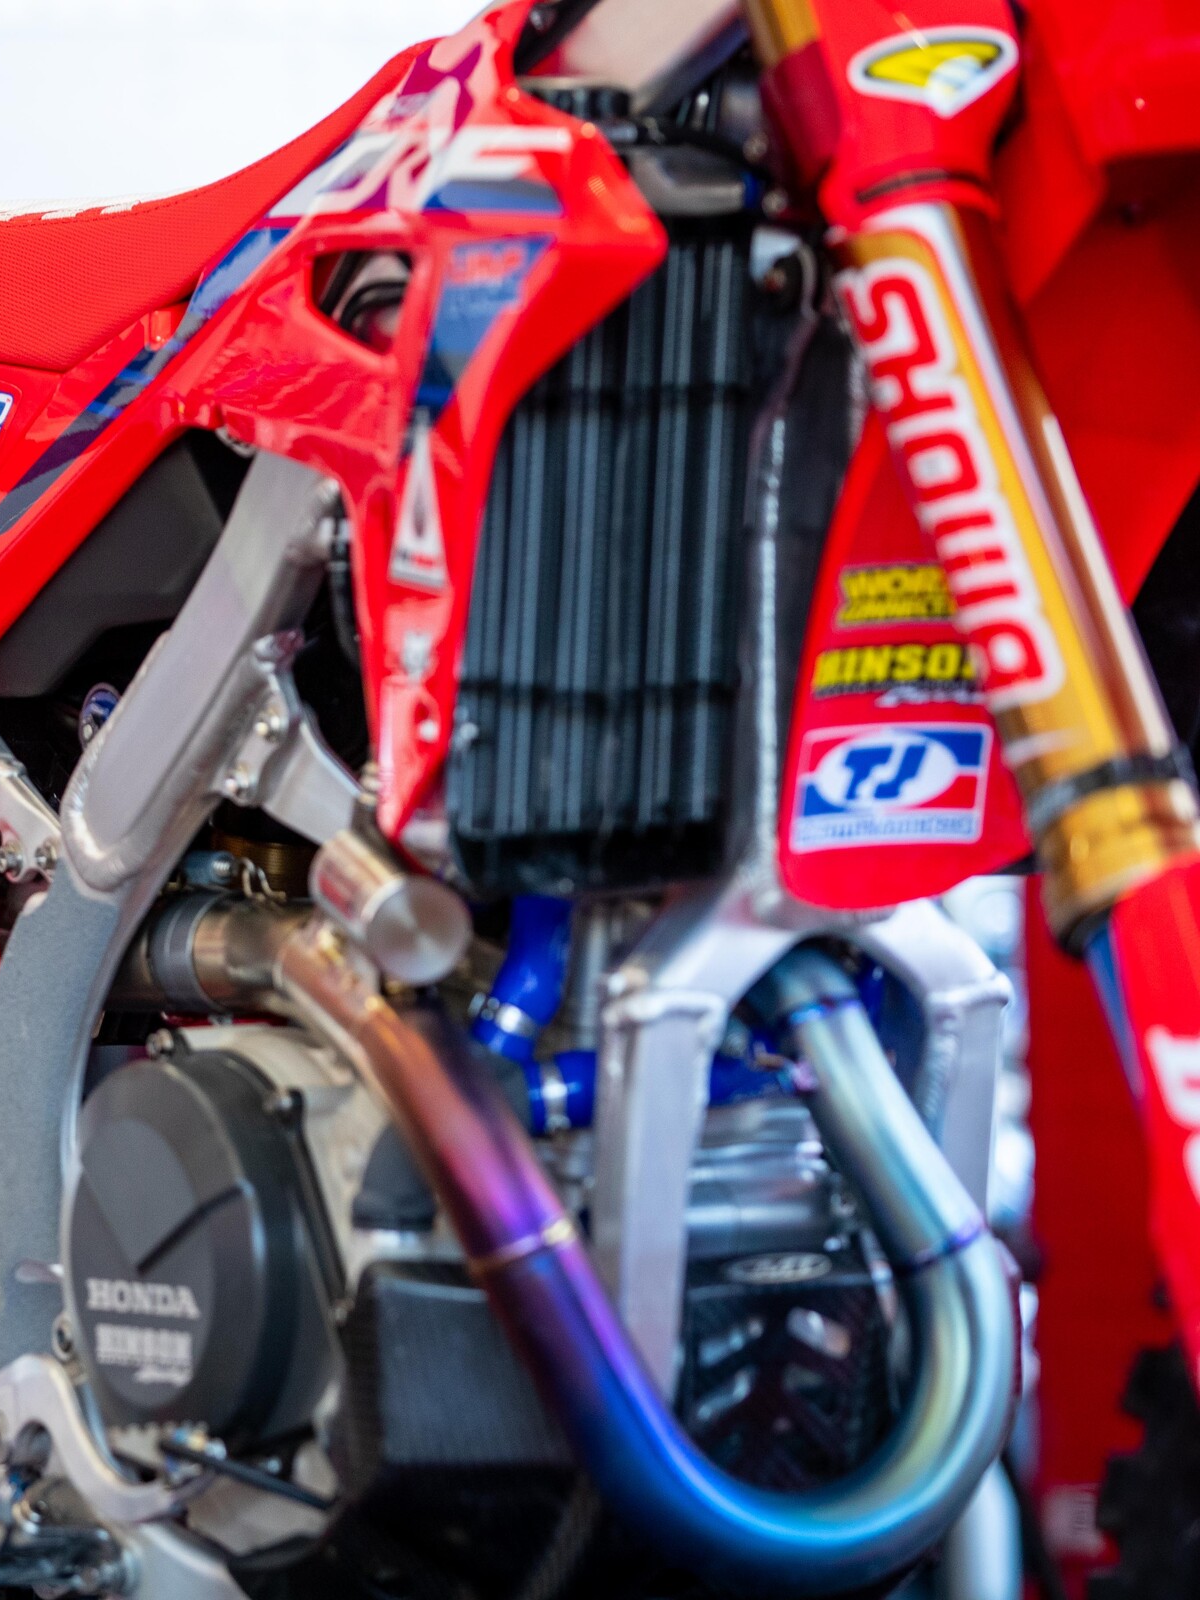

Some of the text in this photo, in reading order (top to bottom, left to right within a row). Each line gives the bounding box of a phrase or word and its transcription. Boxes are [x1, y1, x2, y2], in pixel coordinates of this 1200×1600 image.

[842, 272, 1046, 696] SHOWA
[844, 744, 933, 801] TJ
[86, 1278, 200, 1319] HONDA
